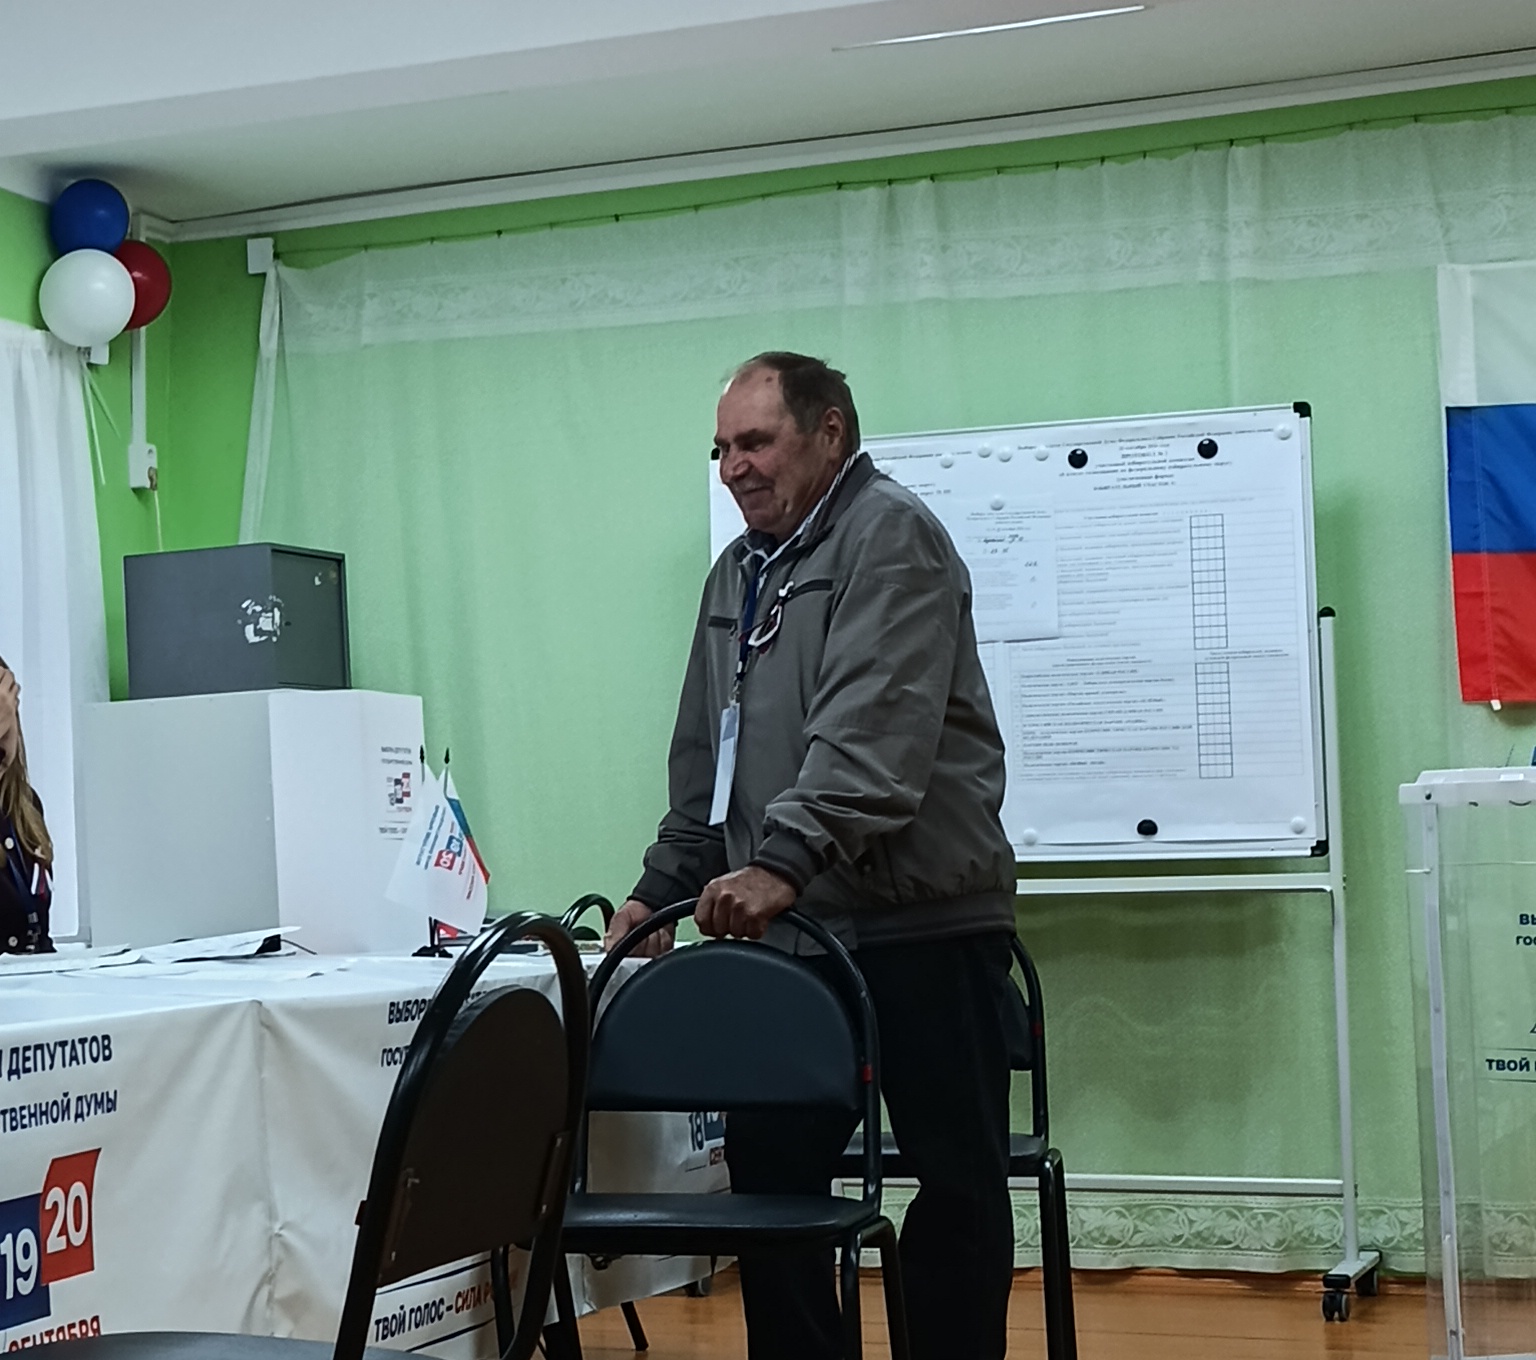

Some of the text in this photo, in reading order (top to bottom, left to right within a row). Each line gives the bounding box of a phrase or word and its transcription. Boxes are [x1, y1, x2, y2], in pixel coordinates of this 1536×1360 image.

[387, 998, 434, 1025] ВЫБОР
[7, 1033, 113, 1082] ДЕПУТАТОВ
[1485, 1056, 1531, 1072] ТВОЙ
[74, 1089, 118, 1123] ДУМЫ
[0, 1226, 40, 1300] 19
[44, 1180, 89, 1254] 20
[374, 1304, 406, 1342] ТВОЙ
[407, 1297, 445, 1331] ГОЛОС
[455, 1287, 482, 1315] СИЛА
